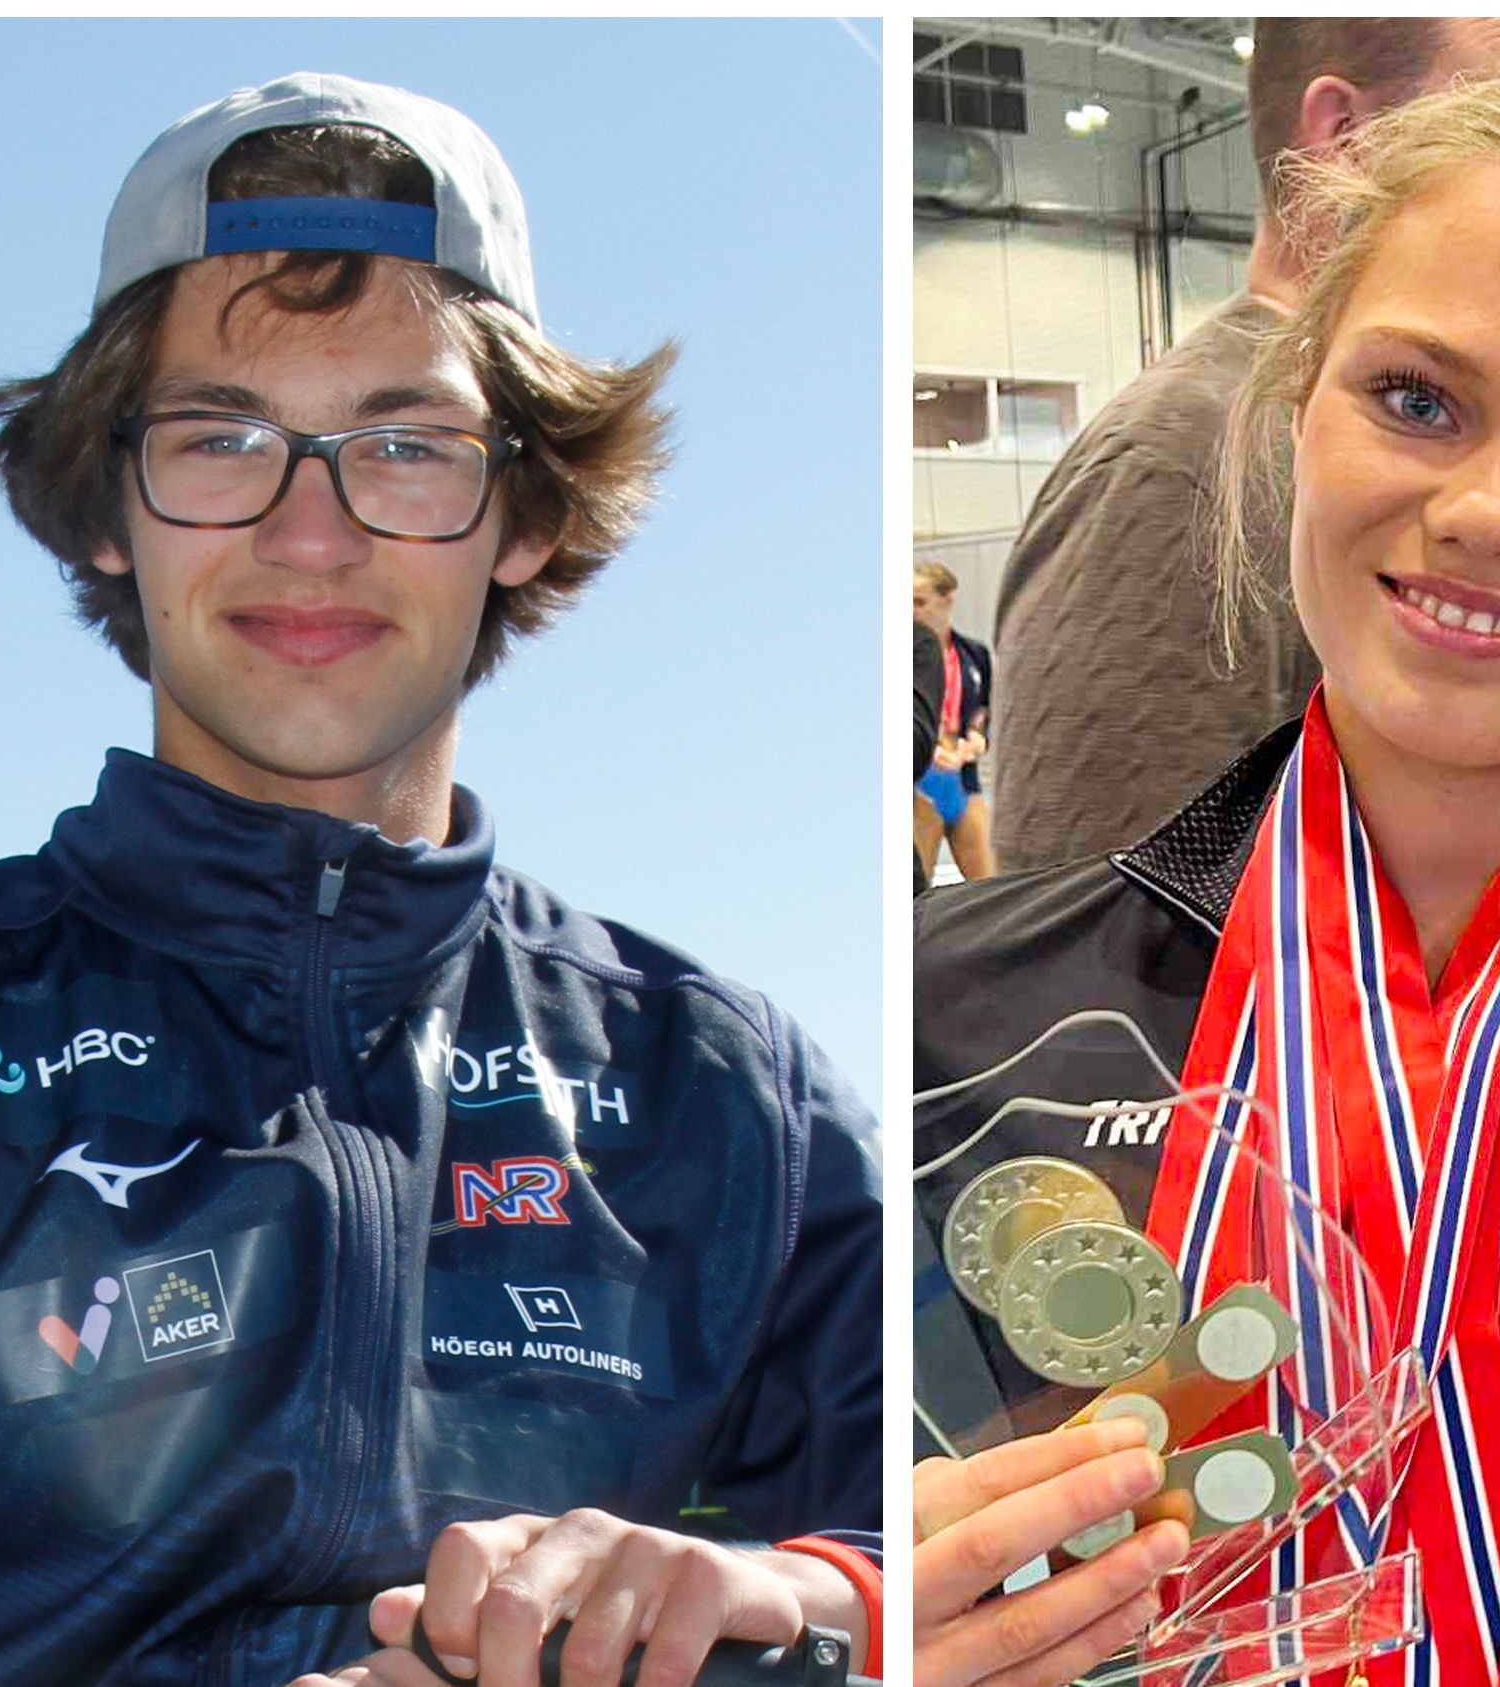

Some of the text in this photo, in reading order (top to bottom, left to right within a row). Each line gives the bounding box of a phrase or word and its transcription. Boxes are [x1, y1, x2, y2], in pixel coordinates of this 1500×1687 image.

[36, 1027, 149, 1088] HBC
[451, 1156, 571, 1228] NR
[534, 1297, 561, 1315] H
[152, 1312, 221, 1348] AKER
[430, 1335, 643, 1381] HÖEGH AUTOLINERS
